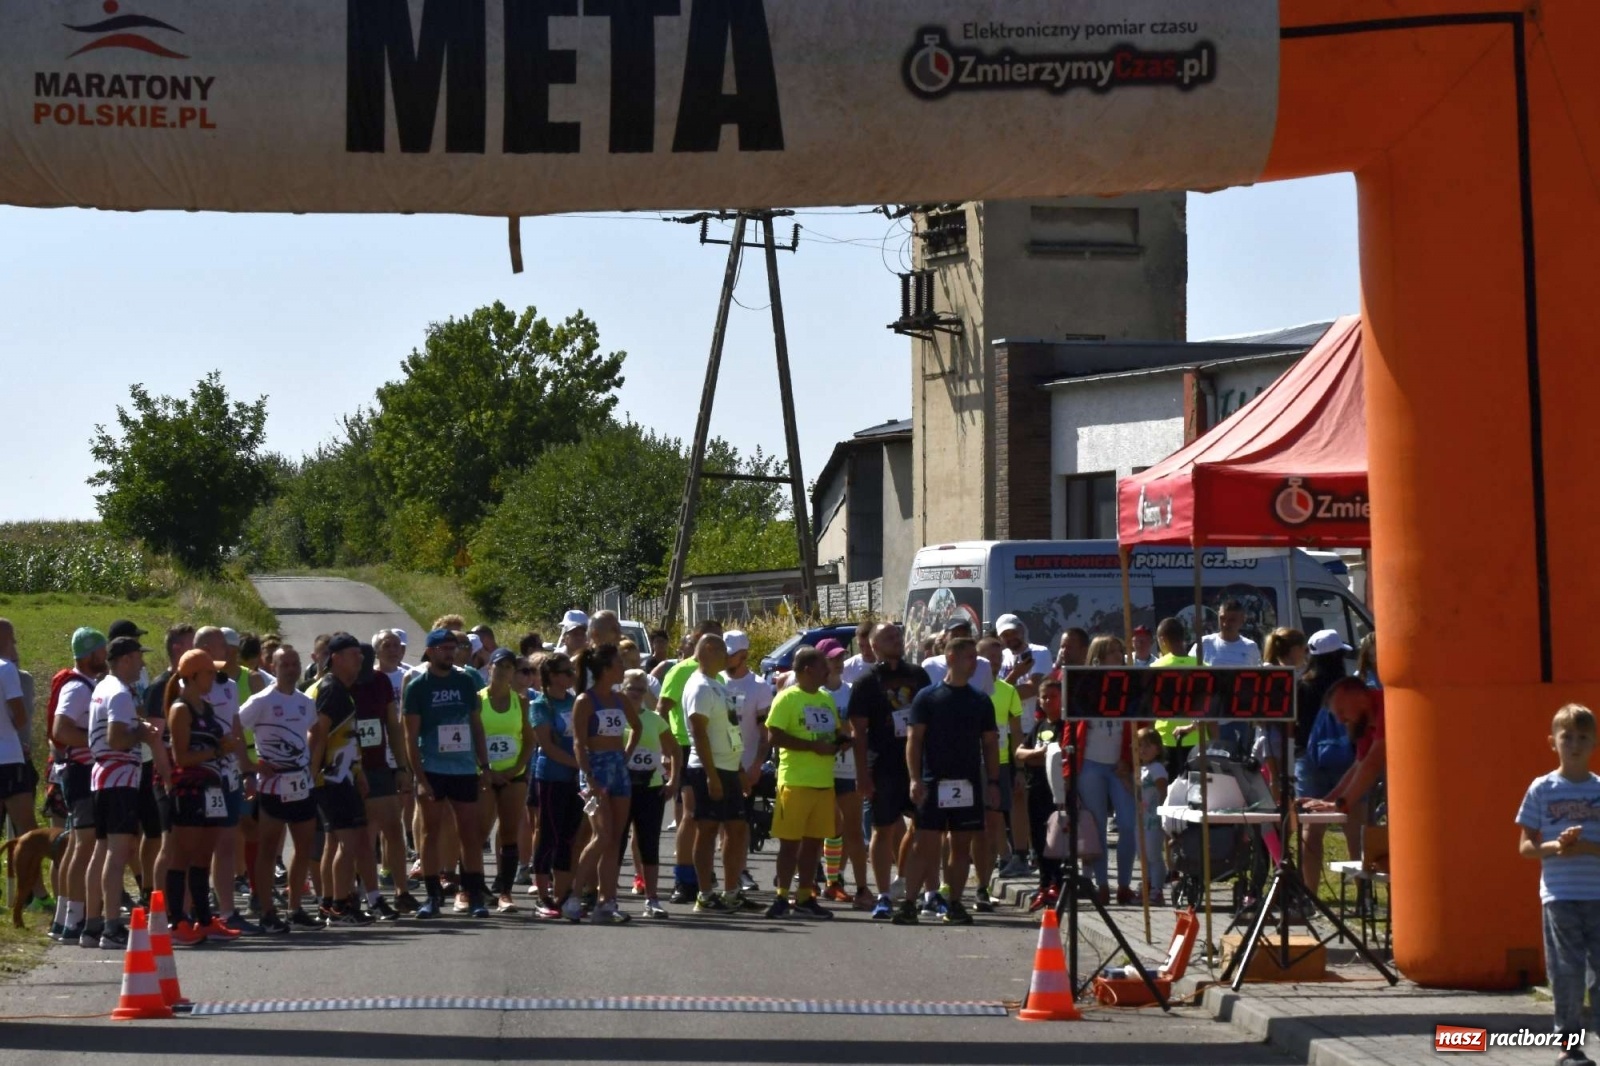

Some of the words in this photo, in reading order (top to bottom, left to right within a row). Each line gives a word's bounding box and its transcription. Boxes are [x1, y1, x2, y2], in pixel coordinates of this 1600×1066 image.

[963, 22, 1080, 41] Elektroniczny
[1085, 20, 1146, 39] pomiar
[1150, 20, 1198, 34] czasu
[958, 49, 1208, 87] ZmierzymyCzas.pl
[346, 0, 785, 153] META
[34, 72, 215, 100] MARATONY
[33, 103, 216, 129] POLSKIE.PL
[432, 689, 461, 702] ZBM
[1100, 672, 1130, 716] 0
[1153, 672, 1215, 716] 00
[1232, 672, 1292, 716] 00
[605, 716, 622, 728] 36
[812, 712, 829, 724] 15
[451, 731, 462, 743] 4
[489, 738, 509, 752] 43
[633, 753, 653, 765] 66
[290, 778, 307, 792] 16
[951, 787, 962, 799] 2
[210, 796, 224, 808] 35
